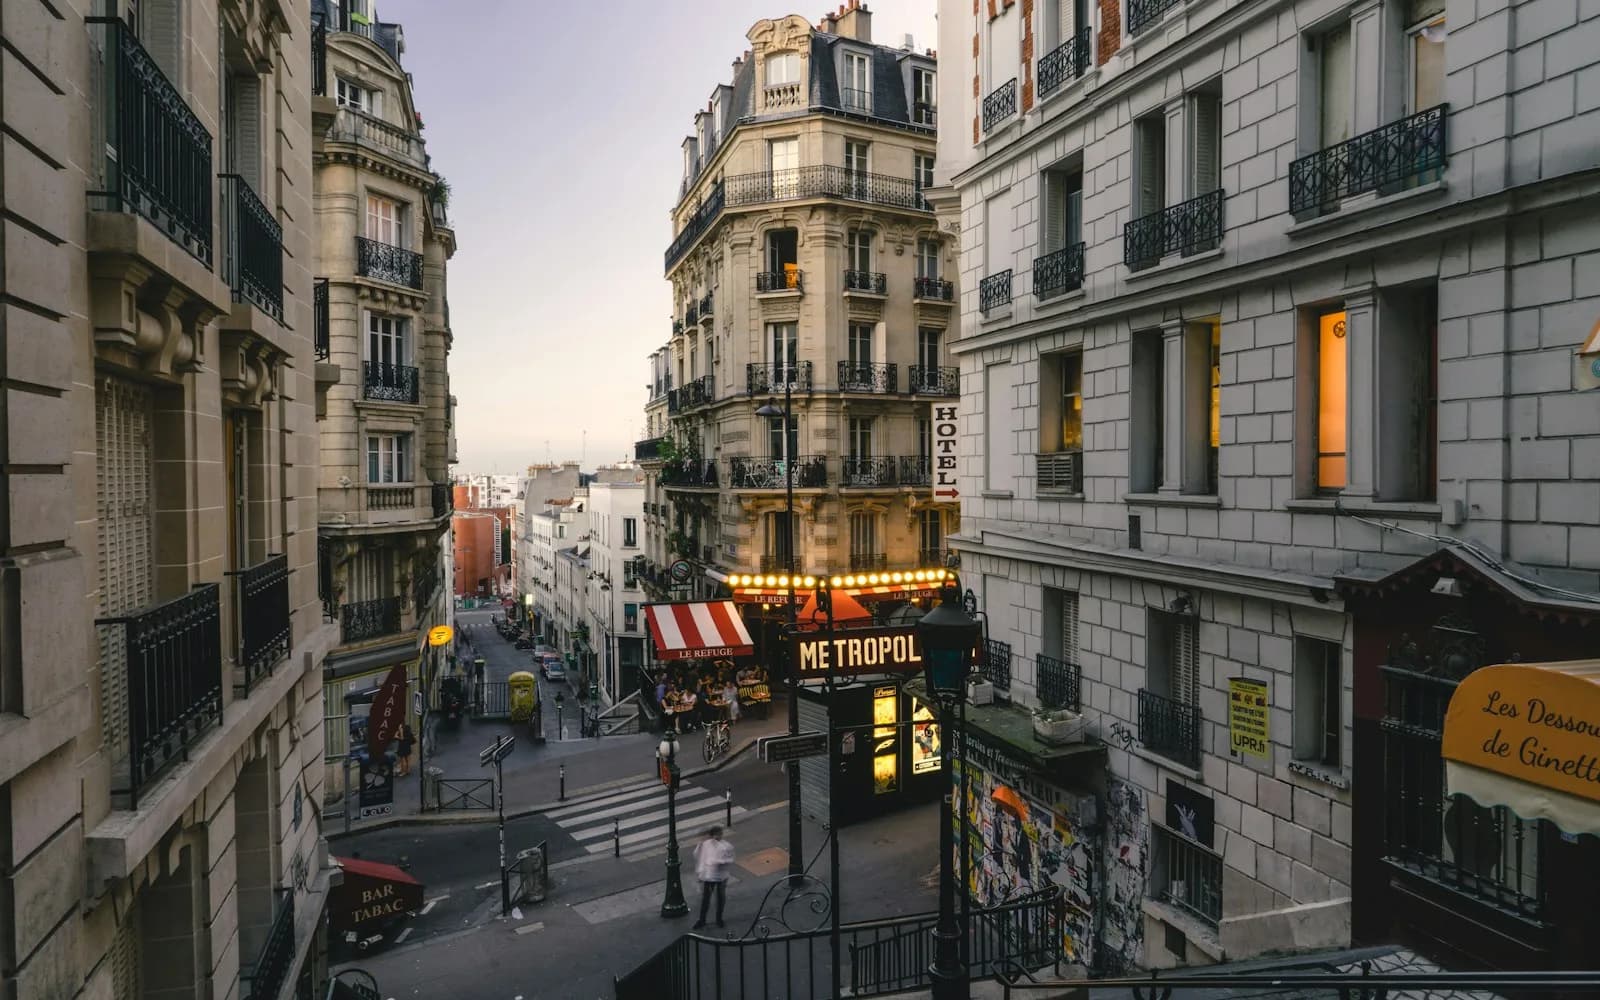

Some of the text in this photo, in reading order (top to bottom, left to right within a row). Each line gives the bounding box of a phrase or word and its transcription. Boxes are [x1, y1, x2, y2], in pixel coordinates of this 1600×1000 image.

[936, 407, 957, 485] HOTEL
[768, 595, 803, 604] REFUE
[679, 648, 734, 658] LE REFUGE
[800, 634, 922, 671] METROPOL
[378, 684, 399, 740] TABAC
[1482, 691, 1519, 718] Les
[1483, 729, 1511, 758] de
[362, 884, 394, 903] BAR
[351, 898, 404, 922] TABAC
